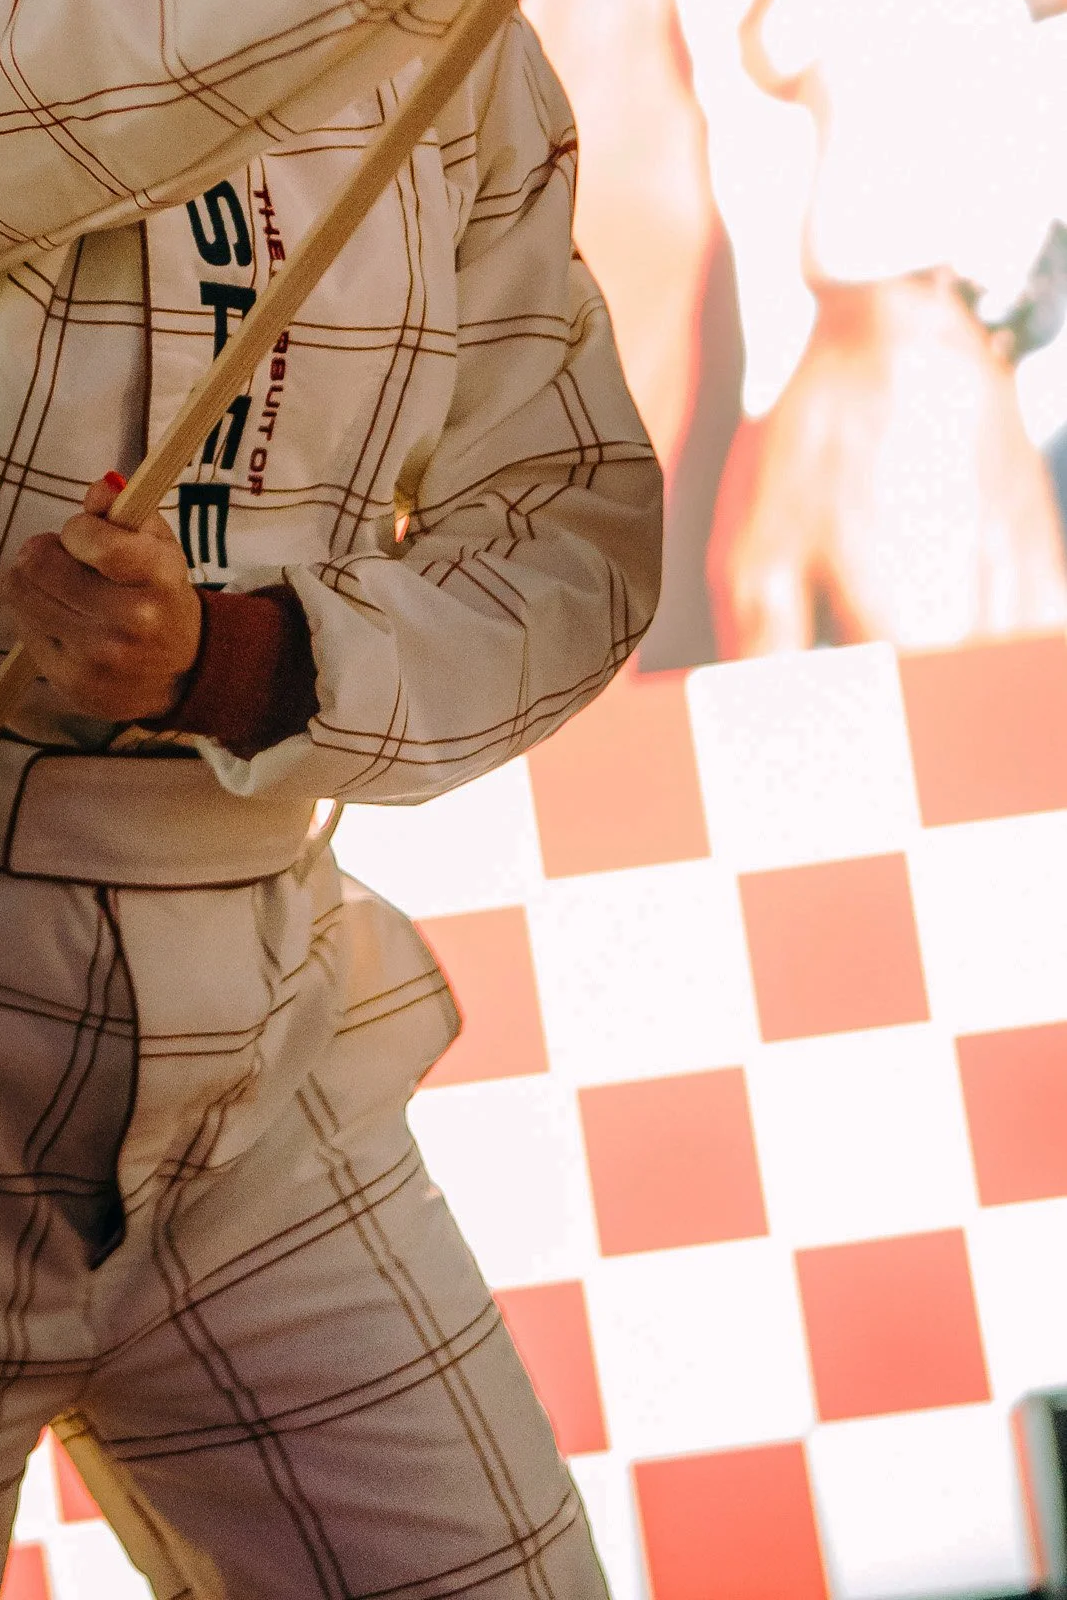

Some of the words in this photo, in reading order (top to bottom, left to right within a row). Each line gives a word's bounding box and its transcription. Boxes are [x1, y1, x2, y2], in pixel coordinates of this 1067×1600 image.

[253, 183, 287, 262] THE
[178, 179, 257, 592] SPEE
[258, 268, 291, 442] RSUIT
